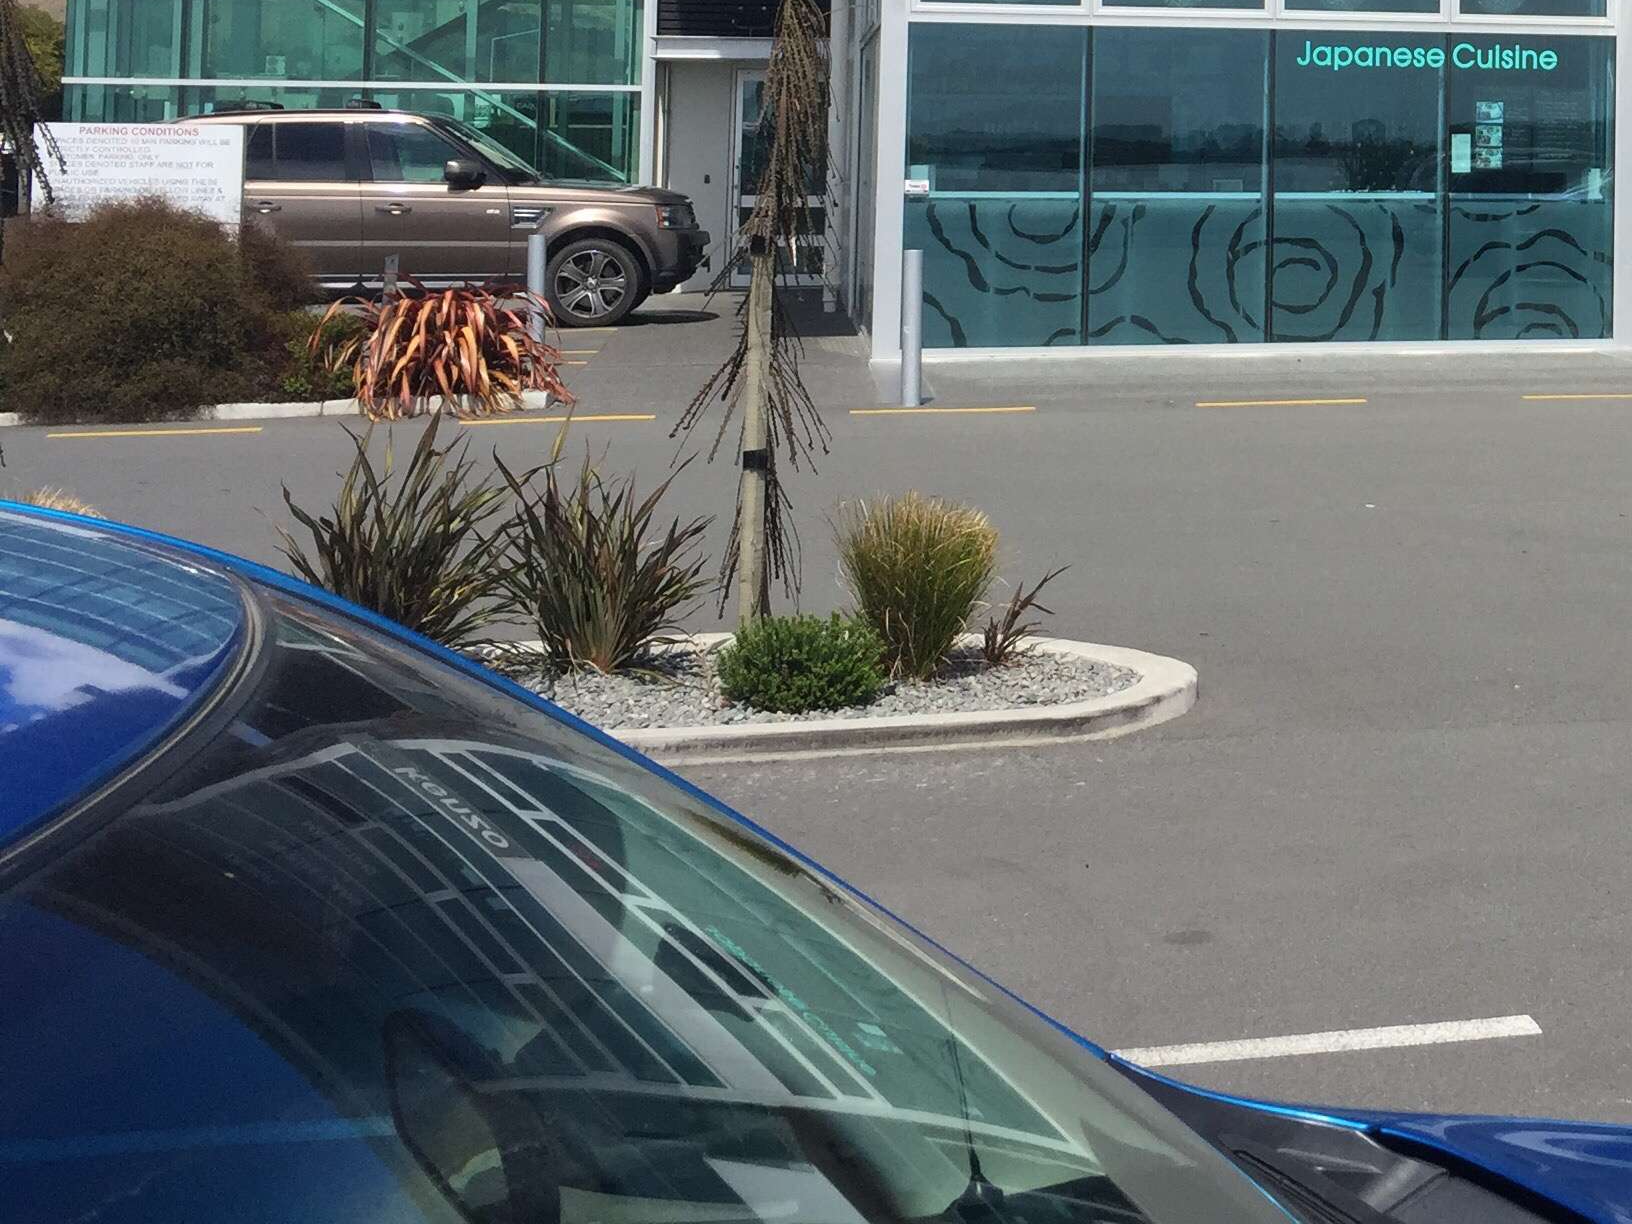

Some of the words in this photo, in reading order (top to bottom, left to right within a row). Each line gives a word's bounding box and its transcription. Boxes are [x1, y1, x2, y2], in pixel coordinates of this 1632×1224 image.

[1296, 40, 1446, 71] Japanese
[1451, 42, 1558, 71] Cuisine
[79, 126, 128, 136] PARKING
[131, 127, 200, 137] CONDITIONS
